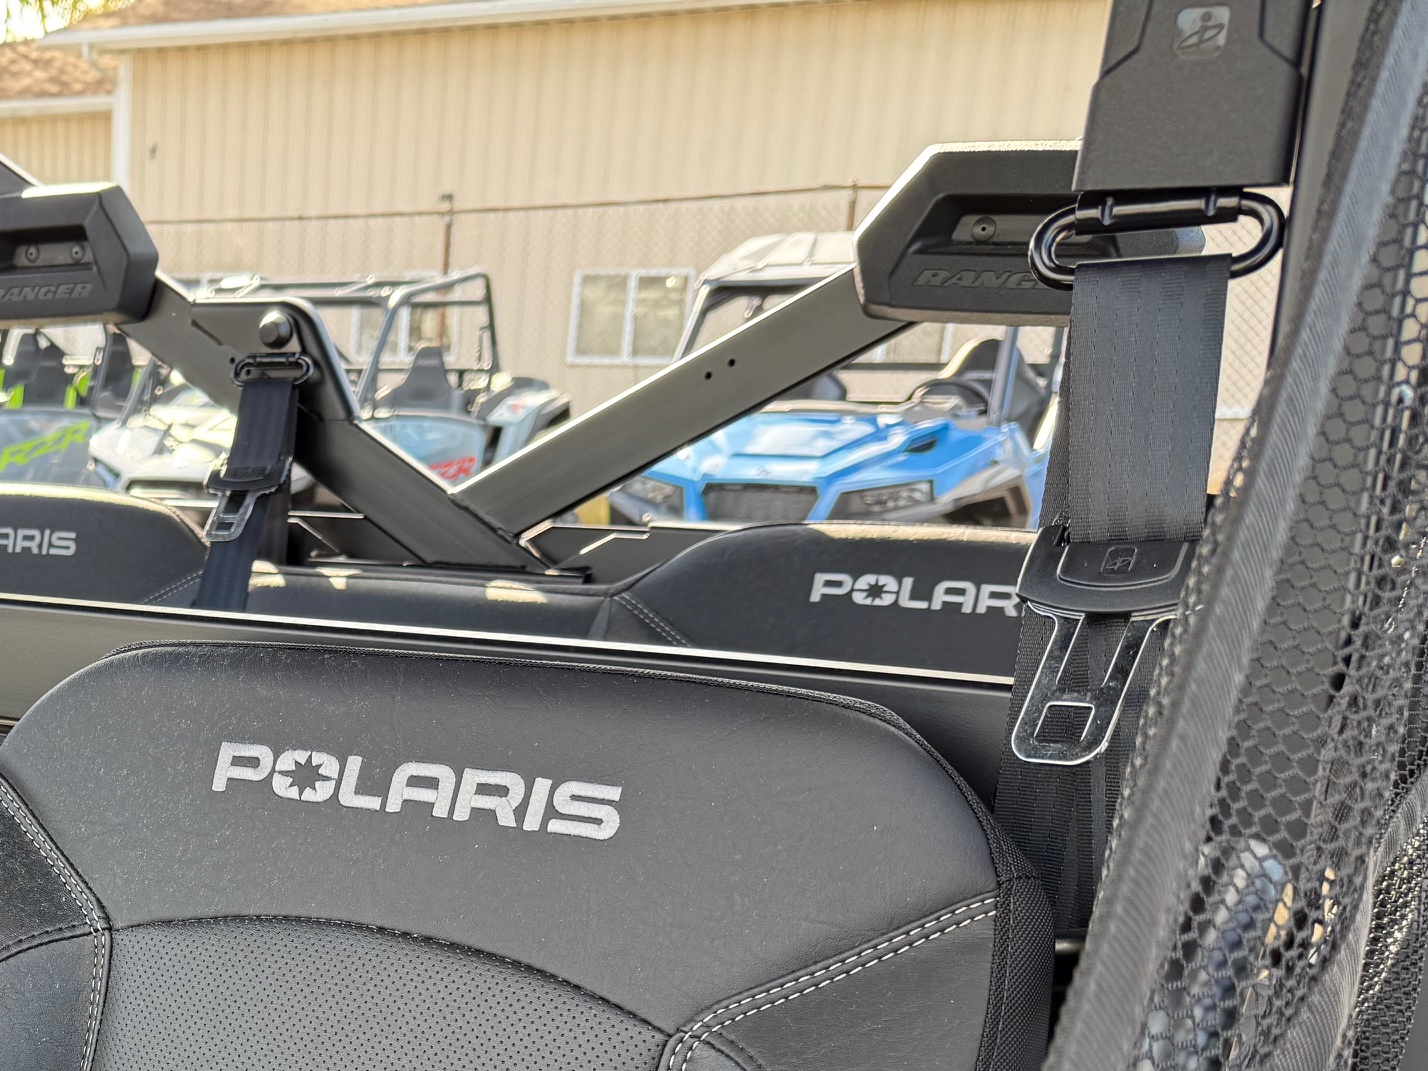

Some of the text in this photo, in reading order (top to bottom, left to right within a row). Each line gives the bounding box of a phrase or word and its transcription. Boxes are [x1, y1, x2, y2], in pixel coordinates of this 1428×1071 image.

[912, 268, 1052, 290] RANG
[427, 455, 477, 481] ZR
[809, 572, 1024, 617] POLAR
[211, 741, 623, 841] POLARIS
